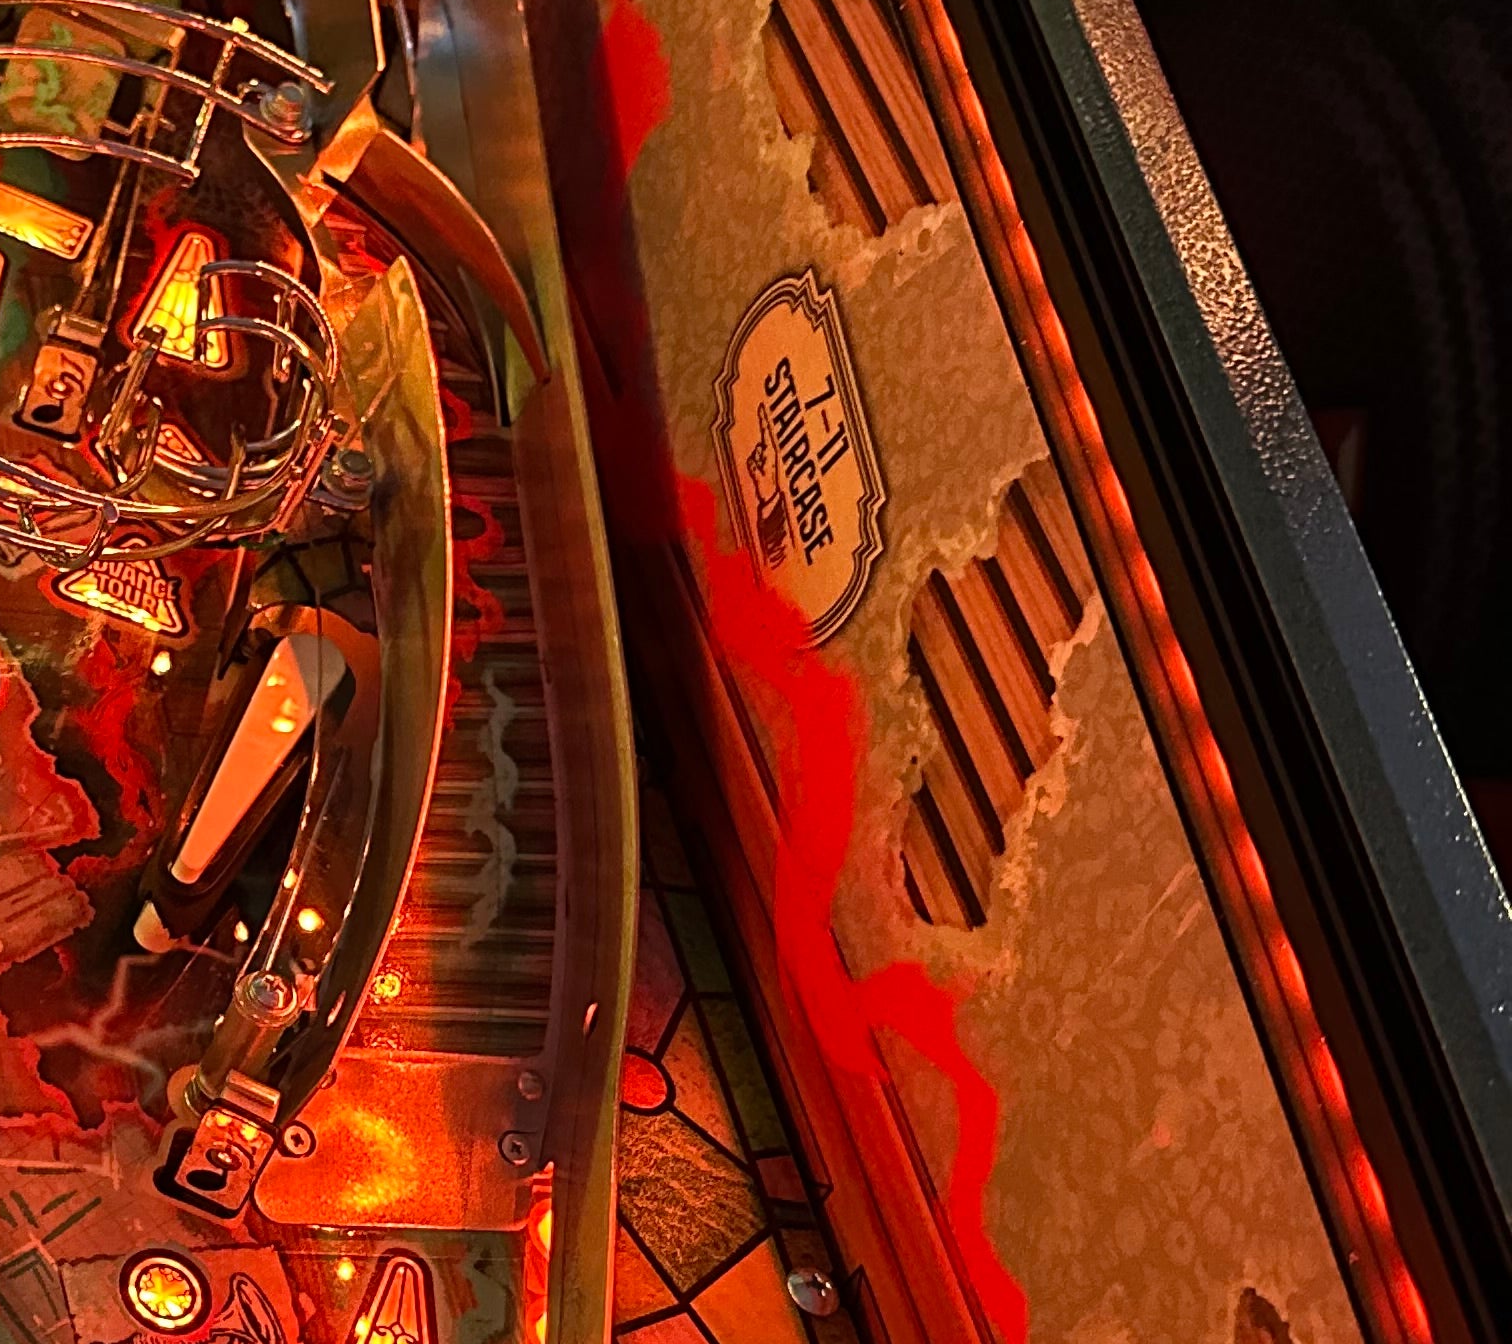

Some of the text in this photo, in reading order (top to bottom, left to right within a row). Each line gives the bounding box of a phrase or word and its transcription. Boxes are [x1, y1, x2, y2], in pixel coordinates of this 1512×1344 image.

[764, 356, 834, 566] STAIRCASE
[804, 374, 850, 476] 7-11
[87, 559, 178, 600] DVANCE
[96, 572, 157, 616] TOUR
